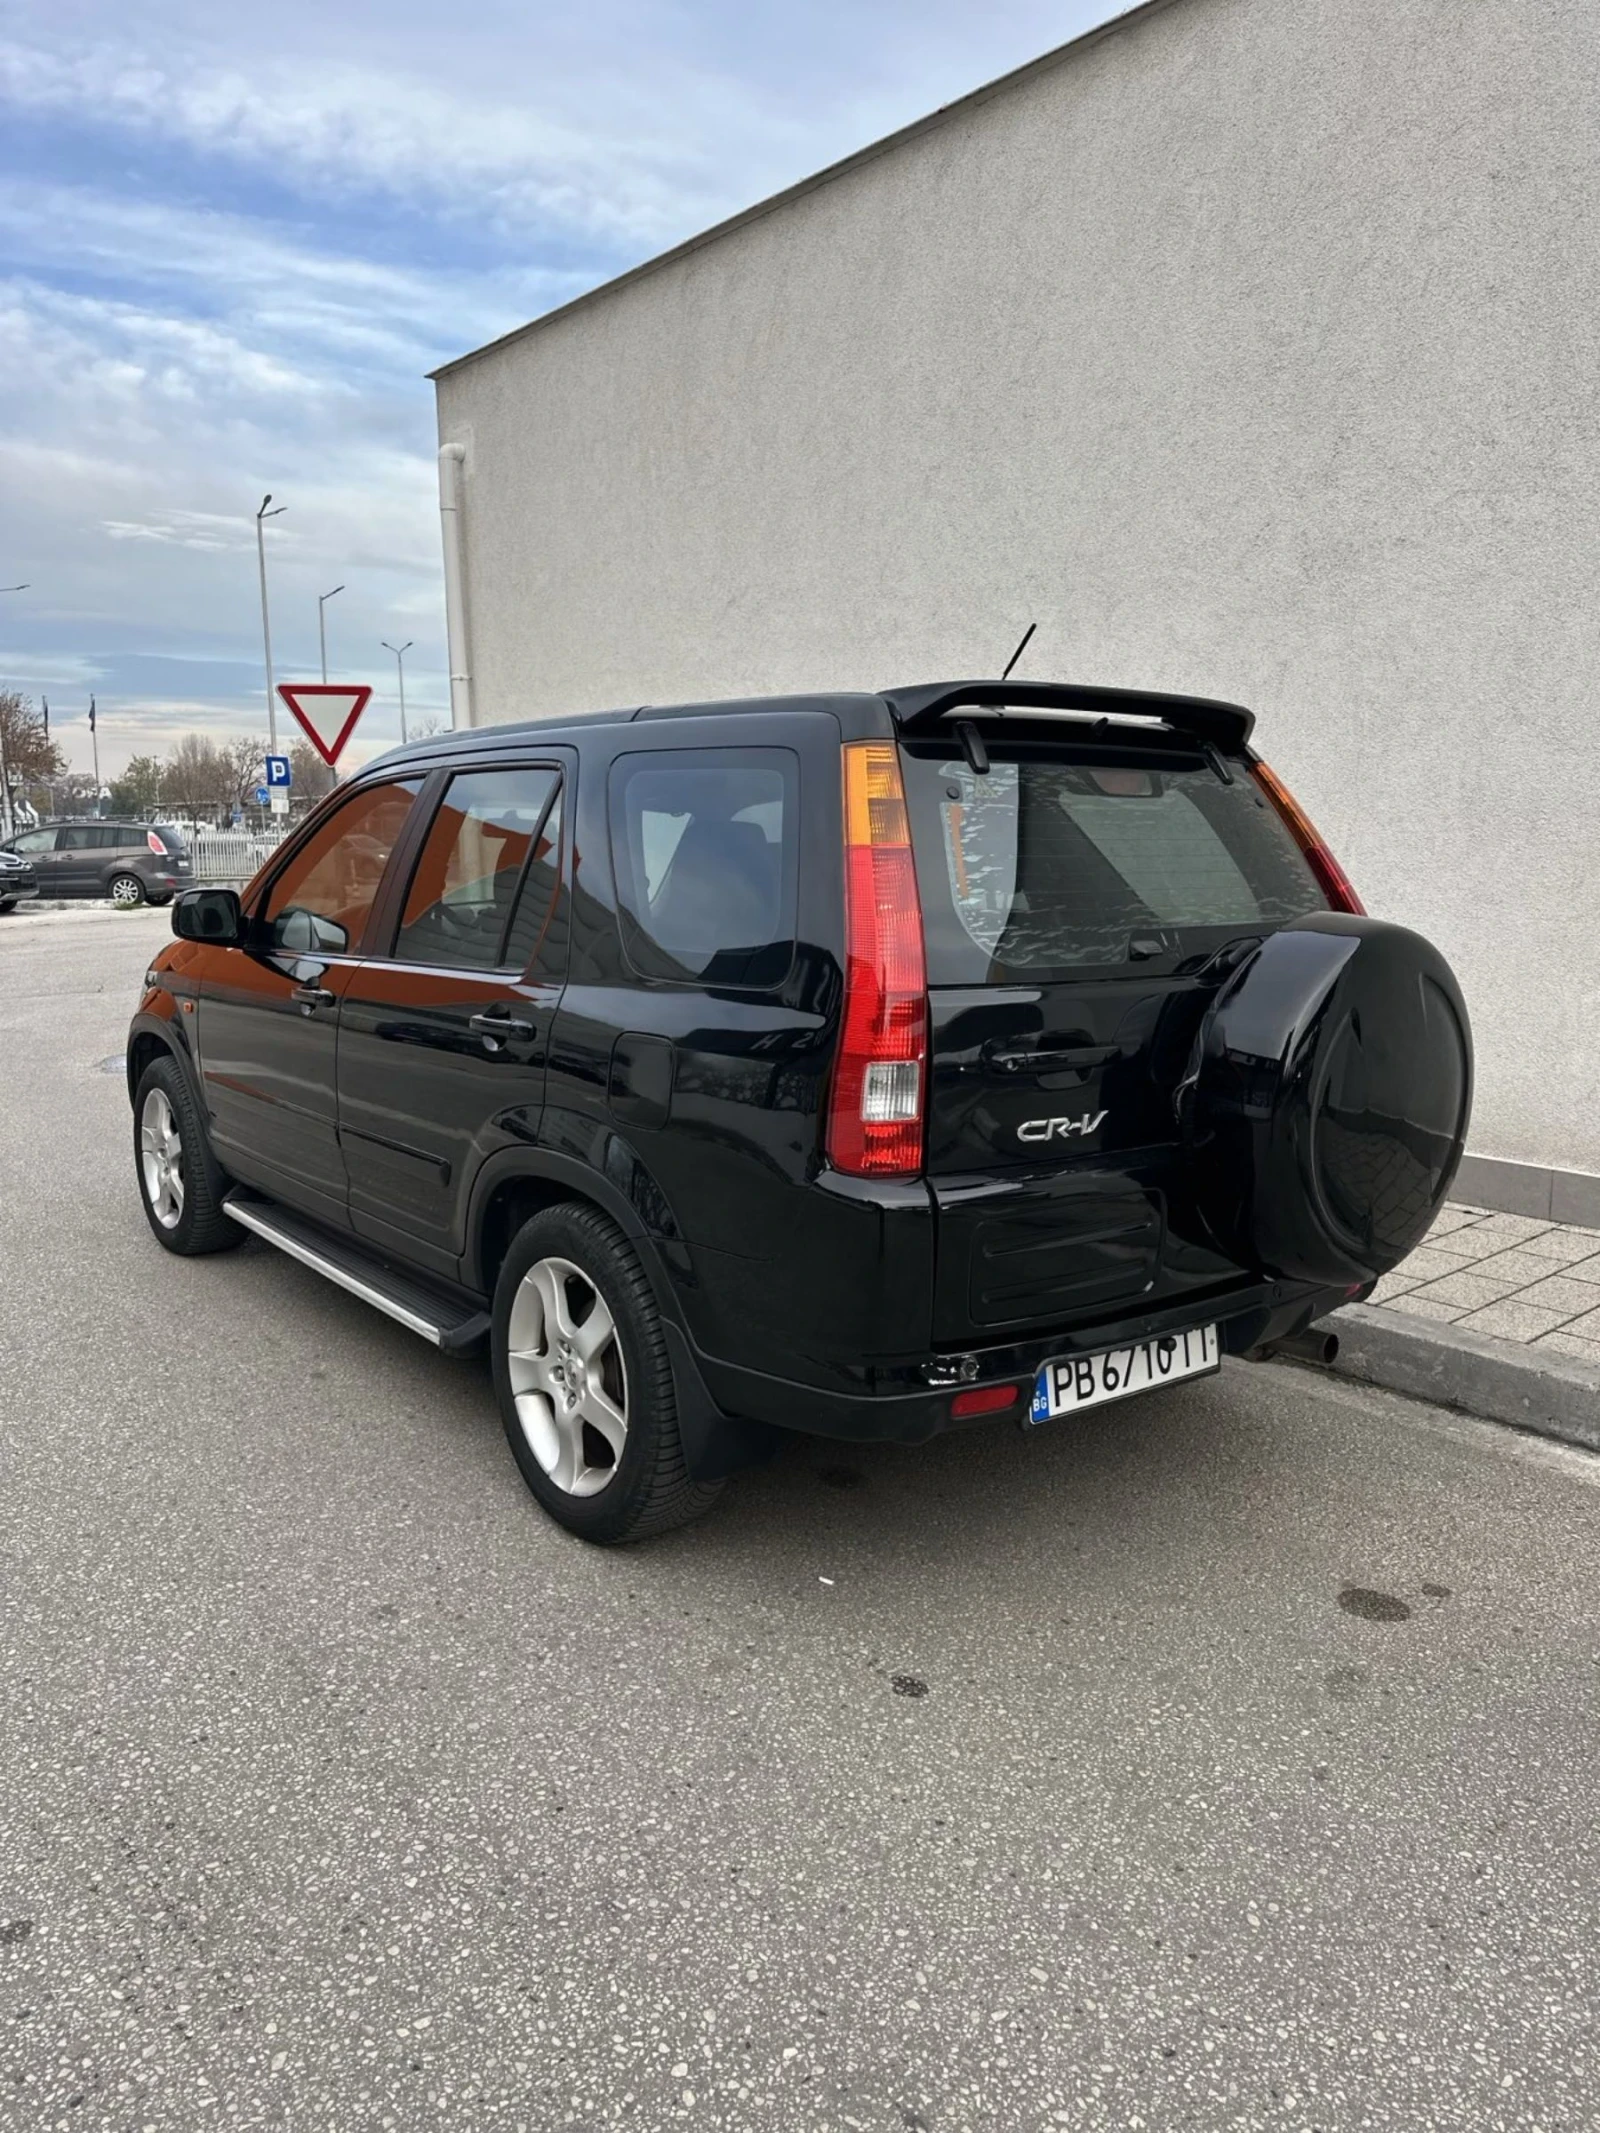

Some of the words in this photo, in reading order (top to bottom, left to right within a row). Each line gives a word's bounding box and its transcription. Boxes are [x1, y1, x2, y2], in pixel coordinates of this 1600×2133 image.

[271, 761, 286, 782] P
[1017, 1110, 1109, 1142] CR-V
[1052, 1358, 1096, 1407] PB
[1032, 1396, 1048, 1412] BG
